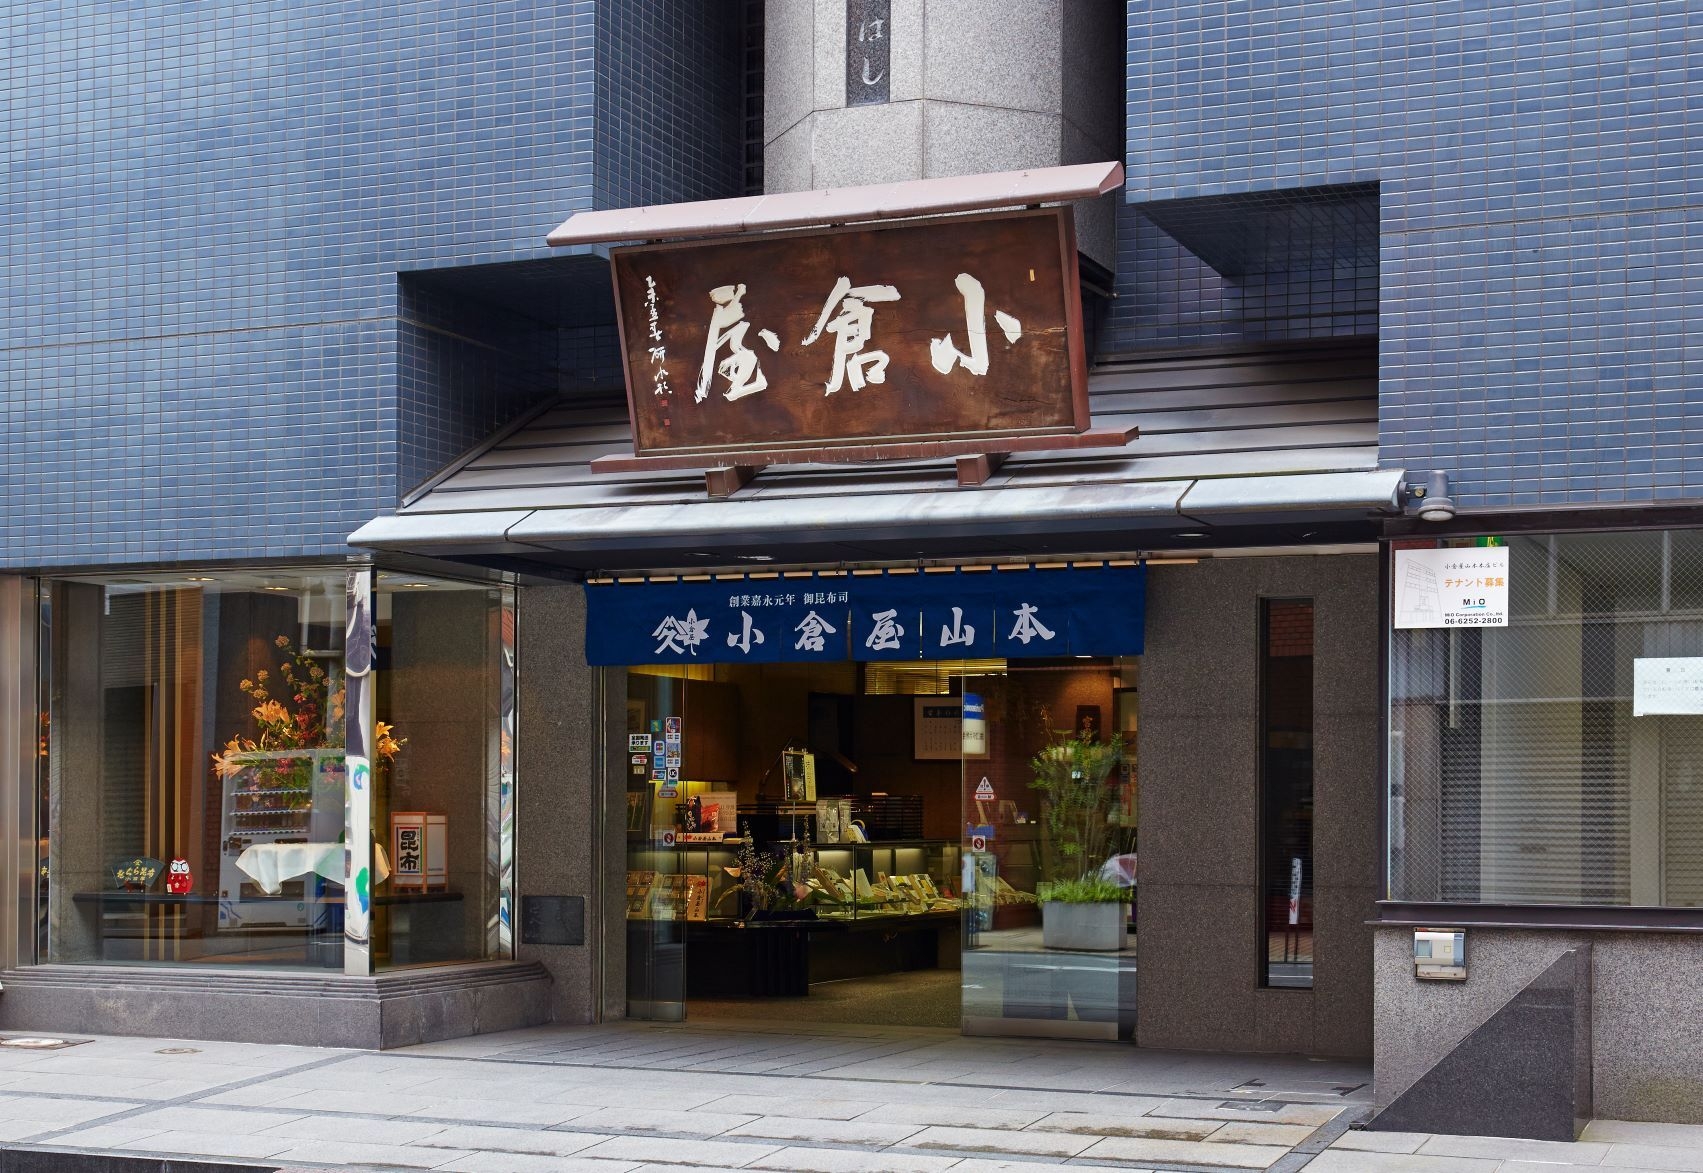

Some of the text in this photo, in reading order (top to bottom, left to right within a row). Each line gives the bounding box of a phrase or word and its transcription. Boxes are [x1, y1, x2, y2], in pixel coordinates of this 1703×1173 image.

[1444, 577, 1505, 588] テナント募集
[729, 592, 849, 607] 創業嘉永元年 御昆布司
[1444, 617, 1503, 625] 06-6252-2800
[399, 830, 420, 871] 昆布
